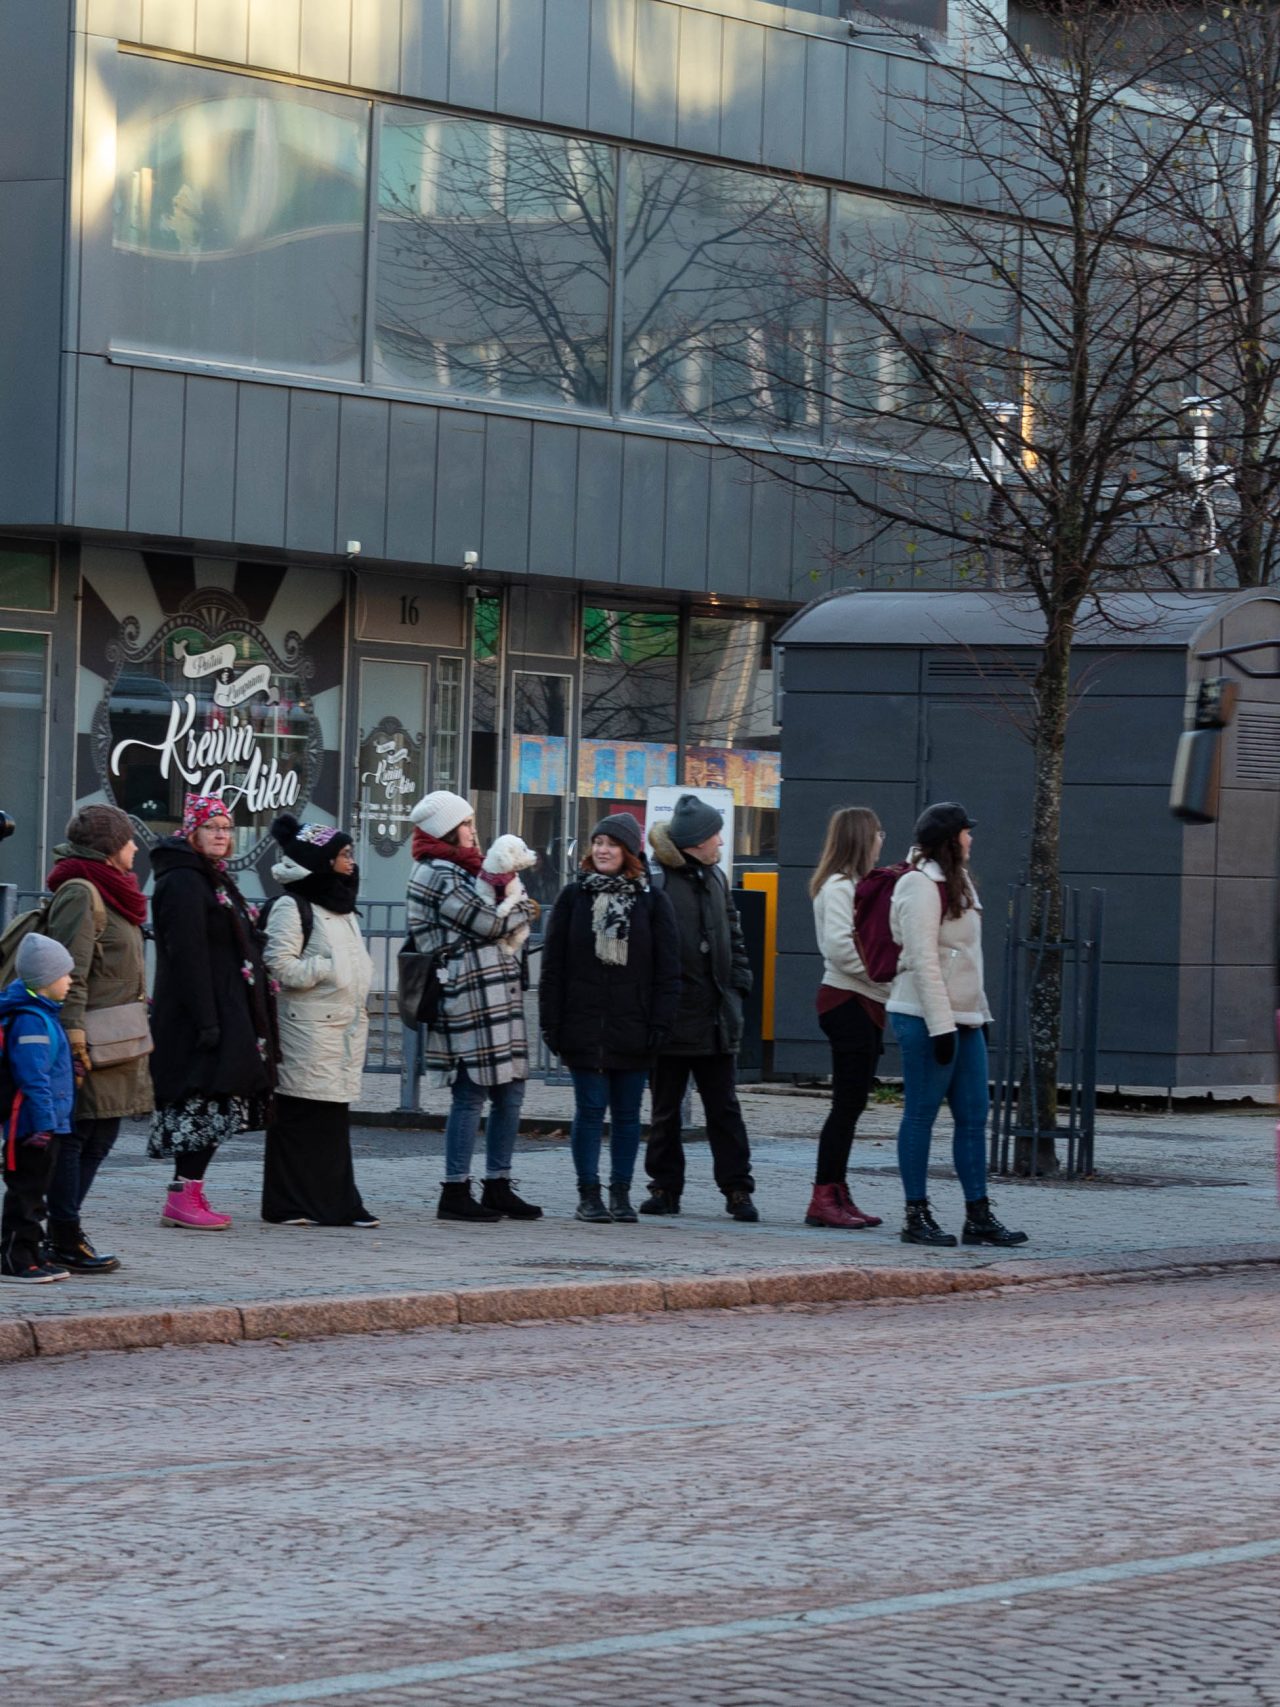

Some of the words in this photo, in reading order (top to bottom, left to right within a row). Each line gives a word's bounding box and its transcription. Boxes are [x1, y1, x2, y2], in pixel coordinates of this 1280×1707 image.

[399, 595, 420, 625] 16
[111, 693, 256, 785] Kreivin
[200, 746, 301, 813] Aika
